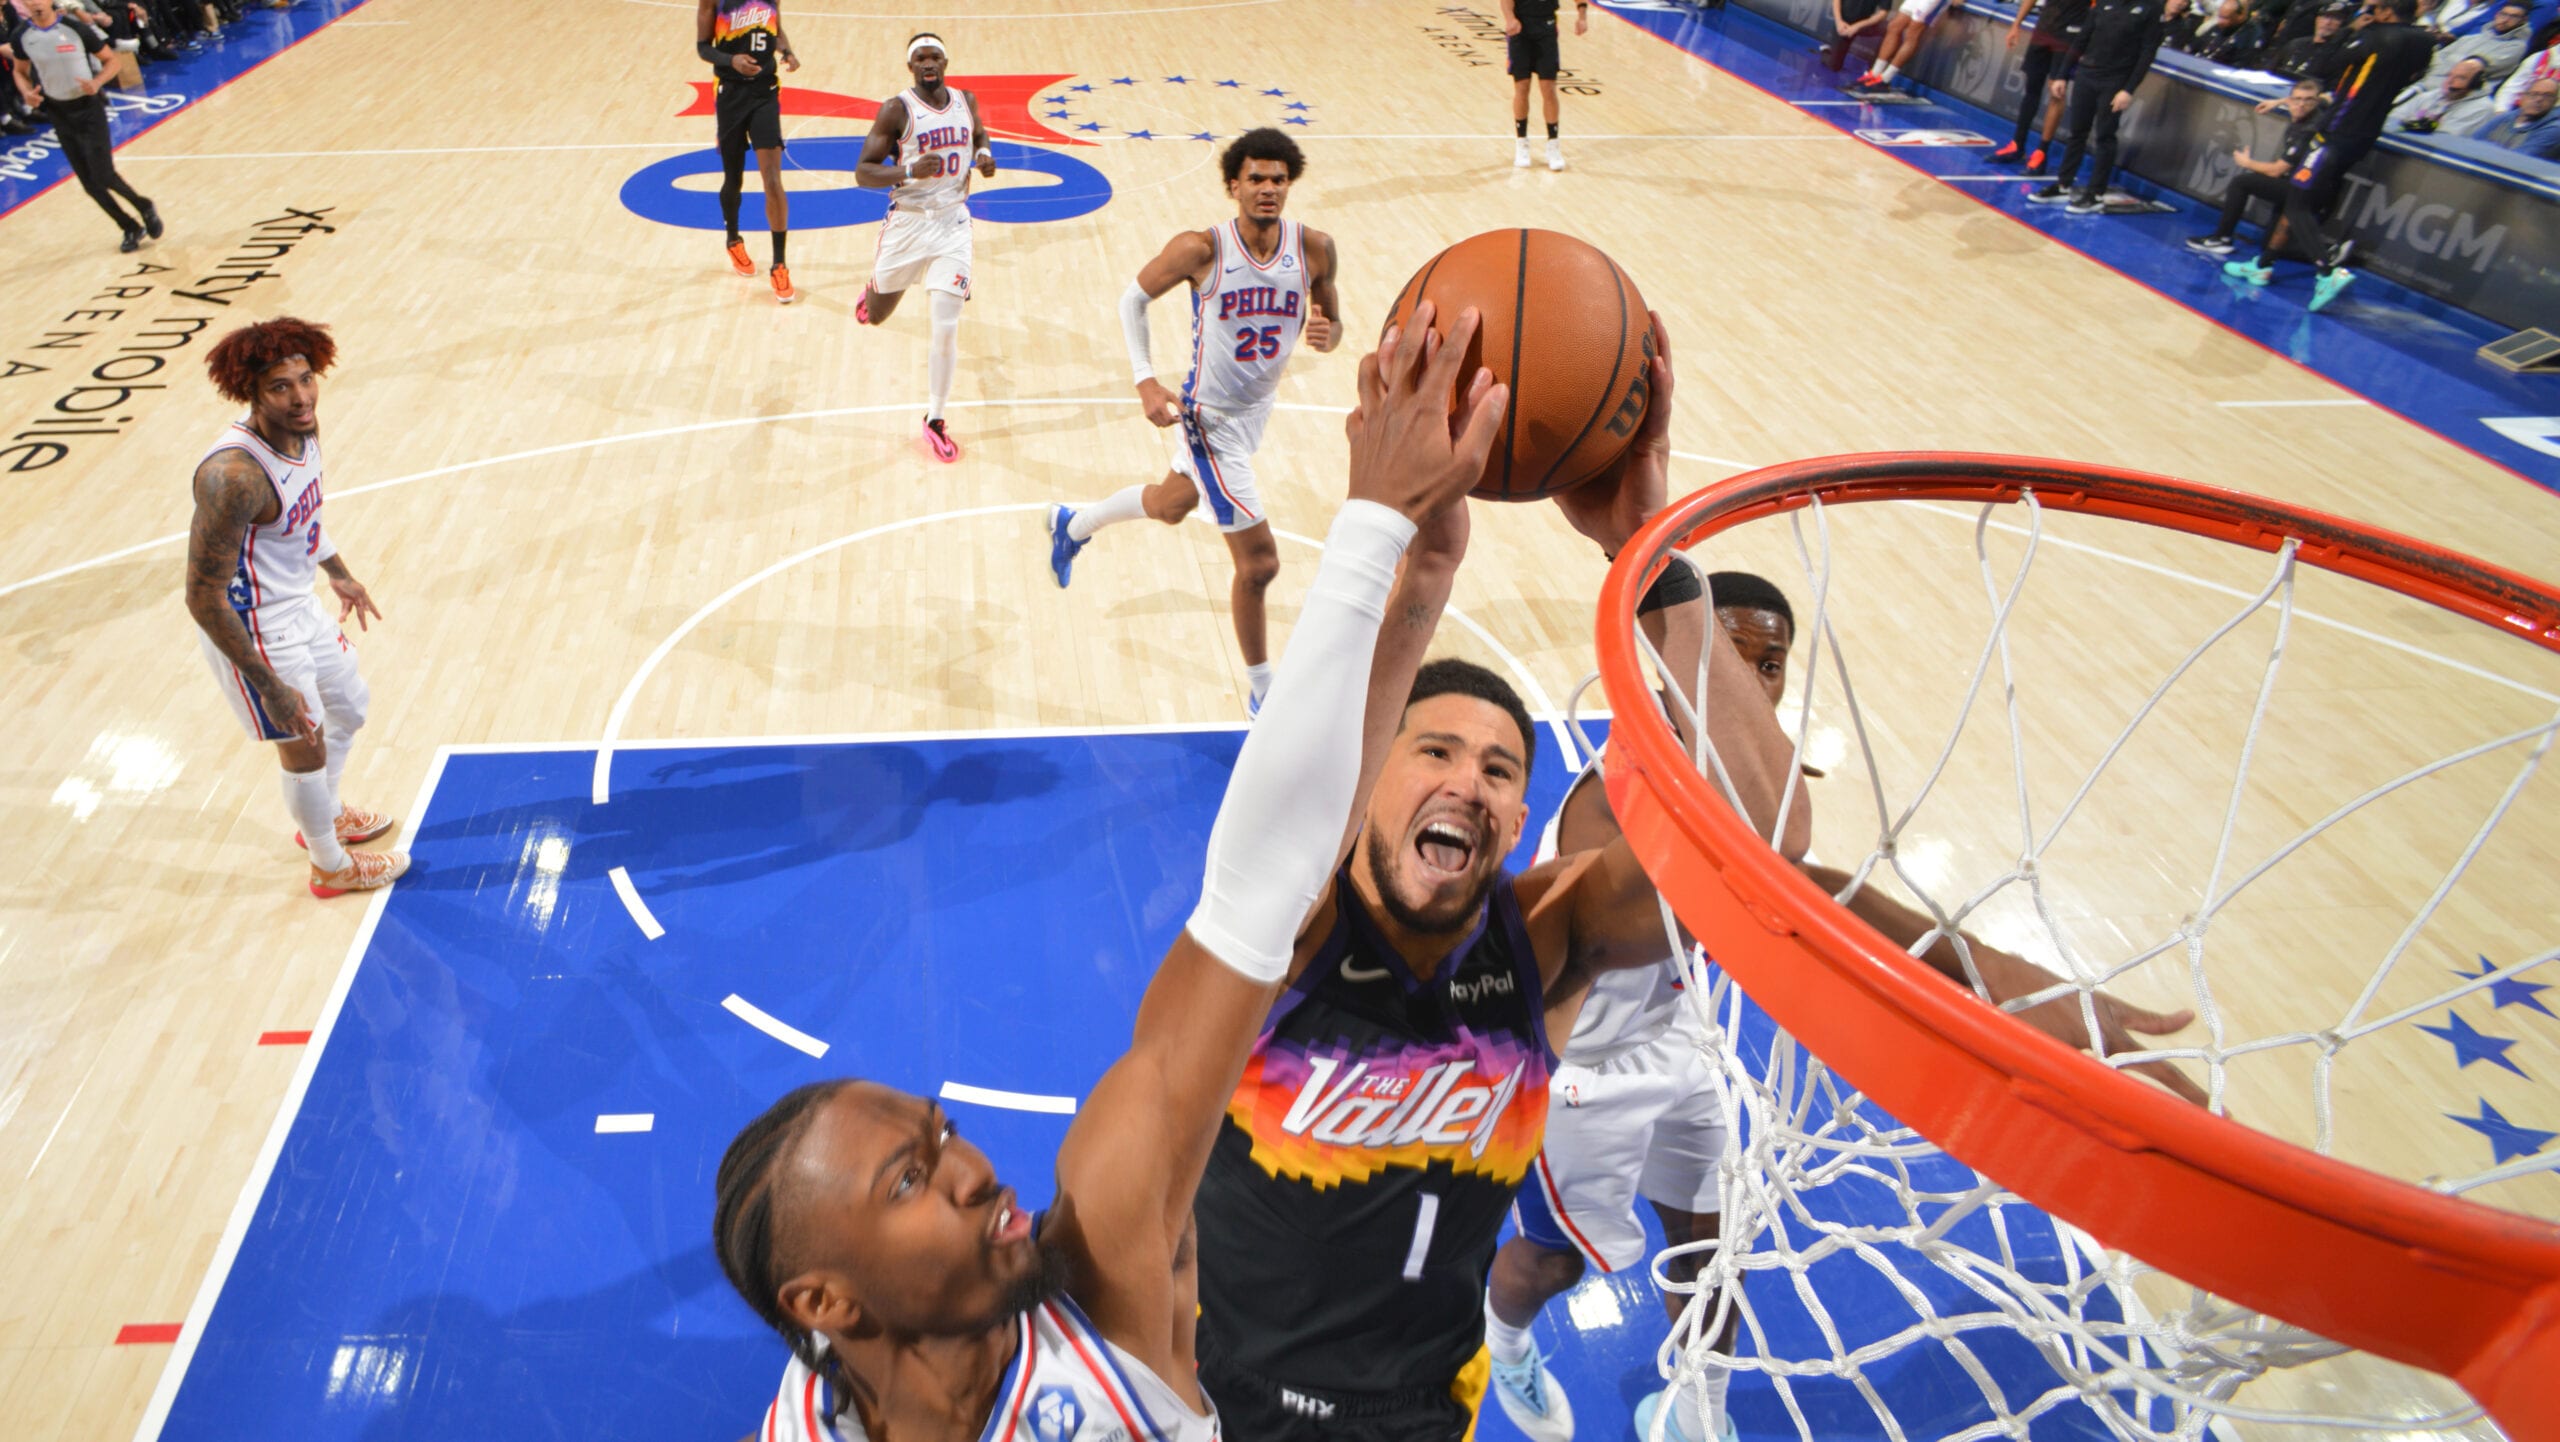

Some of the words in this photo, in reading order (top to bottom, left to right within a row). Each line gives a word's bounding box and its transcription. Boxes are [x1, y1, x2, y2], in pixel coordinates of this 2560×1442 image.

[730, 6, 772, 31] Valley
[750, 32, 767, 51] 15
[1416, 26, 1493, 68] ARENA
[1555, 69, 1605, 96] bile
[2336, 172, 2509, 274] TMGM
[171, 206, 336, 305] xfinity
[952, 273, 969, 290] 76
[0, 262, 175, 378] ARENA
[1218, 286, 1300, 321] PHILA
[1235, 325, 1282, 362] 25
[0, 317, 215, 472] mobile
[281, 474, 323, 537] PHIL
[306, 520, 321, 556] 9
[1359, 1074, 1411, 1095] THE
[1402, 1192, 1441, 1283] 1
[1282, 1387, 1337, 1420] PHX
